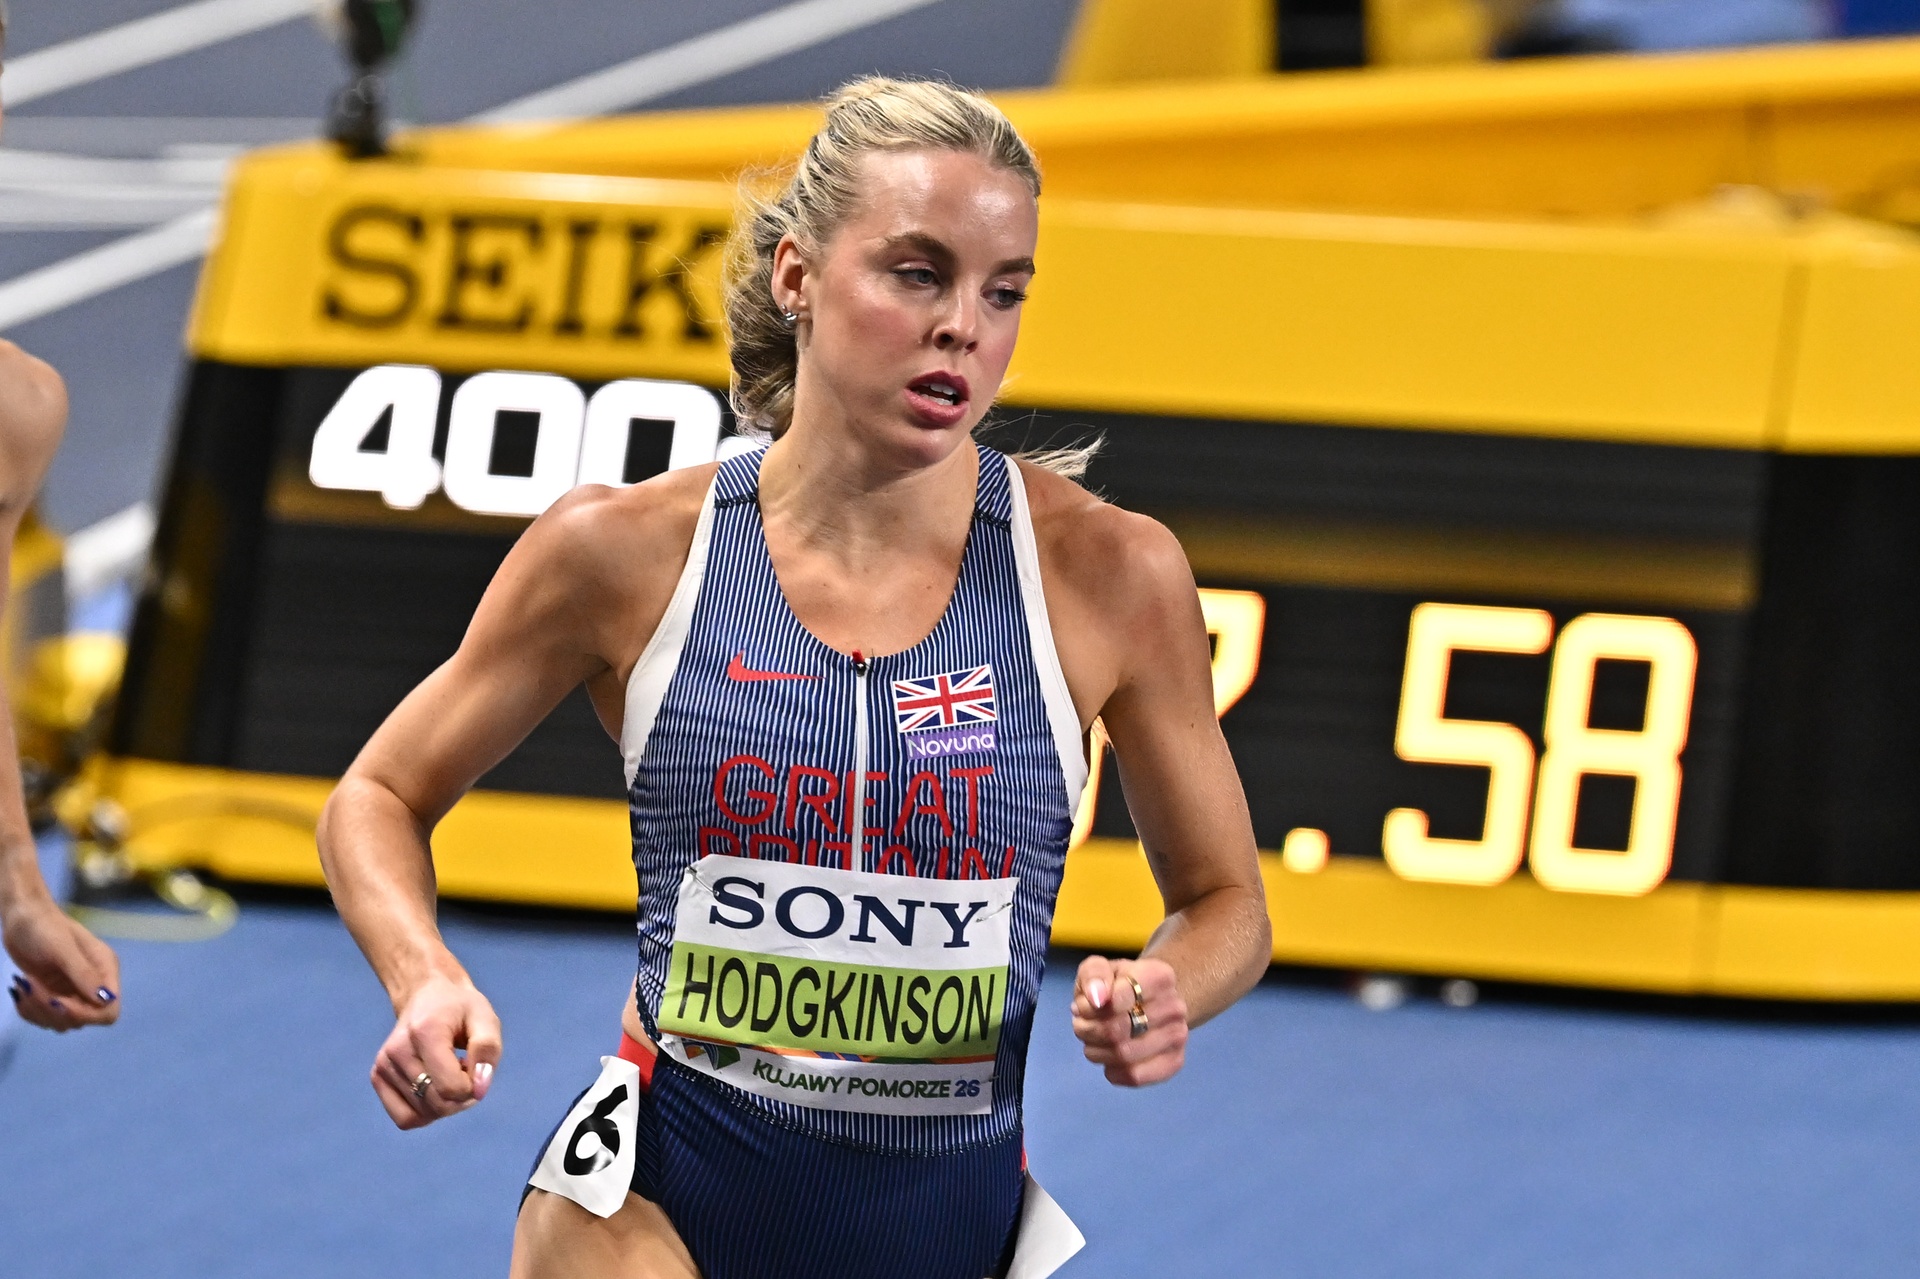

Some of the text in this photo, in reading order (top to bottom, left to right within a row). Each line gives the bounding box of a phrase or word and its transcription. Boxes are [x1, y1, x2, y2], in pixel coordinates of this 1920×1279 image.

[320, 203, 729, 346] SEIK
[309, 363, 767, 517] 400
[907, 732, 996, 759] Novuna
[713, 754, 994, 839] GREAT
[708, 876, 988, 949] SONY
[677, 951, 996, 1045] HODGKINSON
[752, 1058, 981, 1098] KUJAWY POMORZE 26
[563, 1083, 628, 1177] 6
